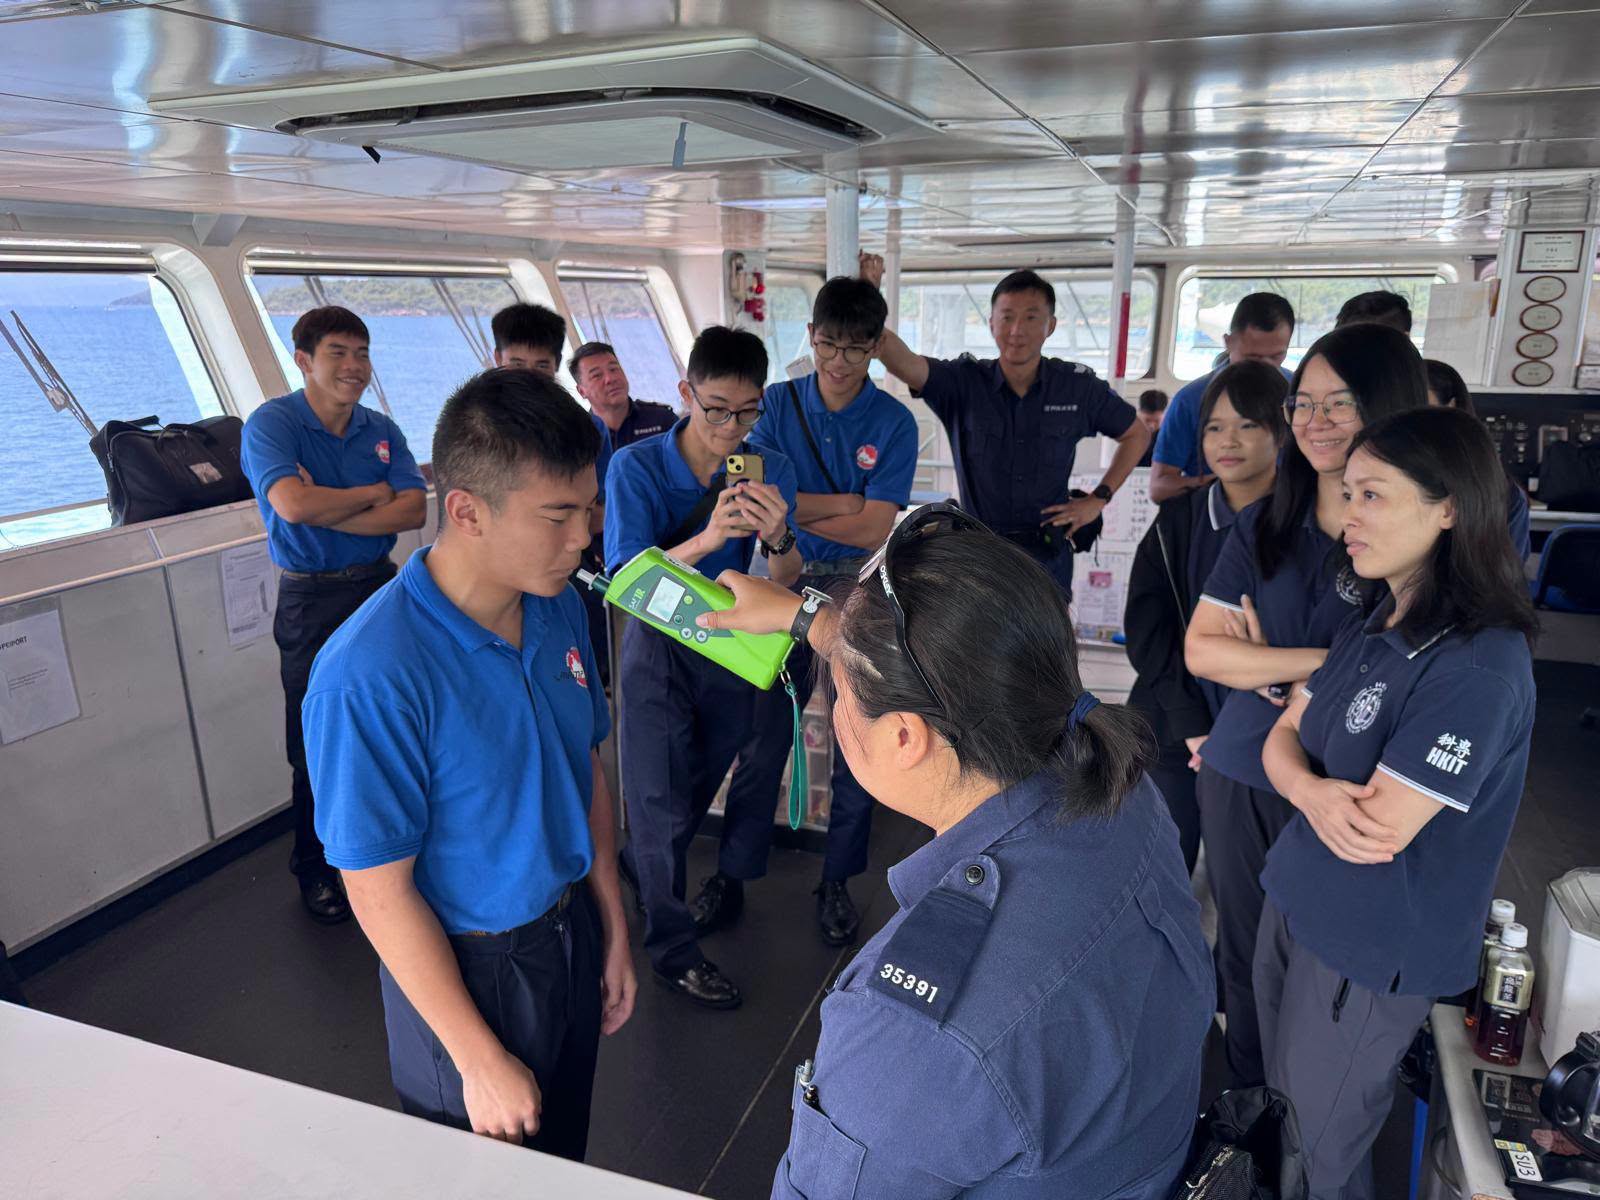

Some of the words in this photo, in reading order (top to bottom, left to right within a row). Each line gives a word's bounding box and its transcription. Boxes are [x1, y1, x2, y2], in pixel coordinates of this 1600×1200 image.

[1425, 746, 1468, 775] HKIT
[879, 963, 938, 1003] 35391
[1514, 1154, 1537, 1179] SU3
